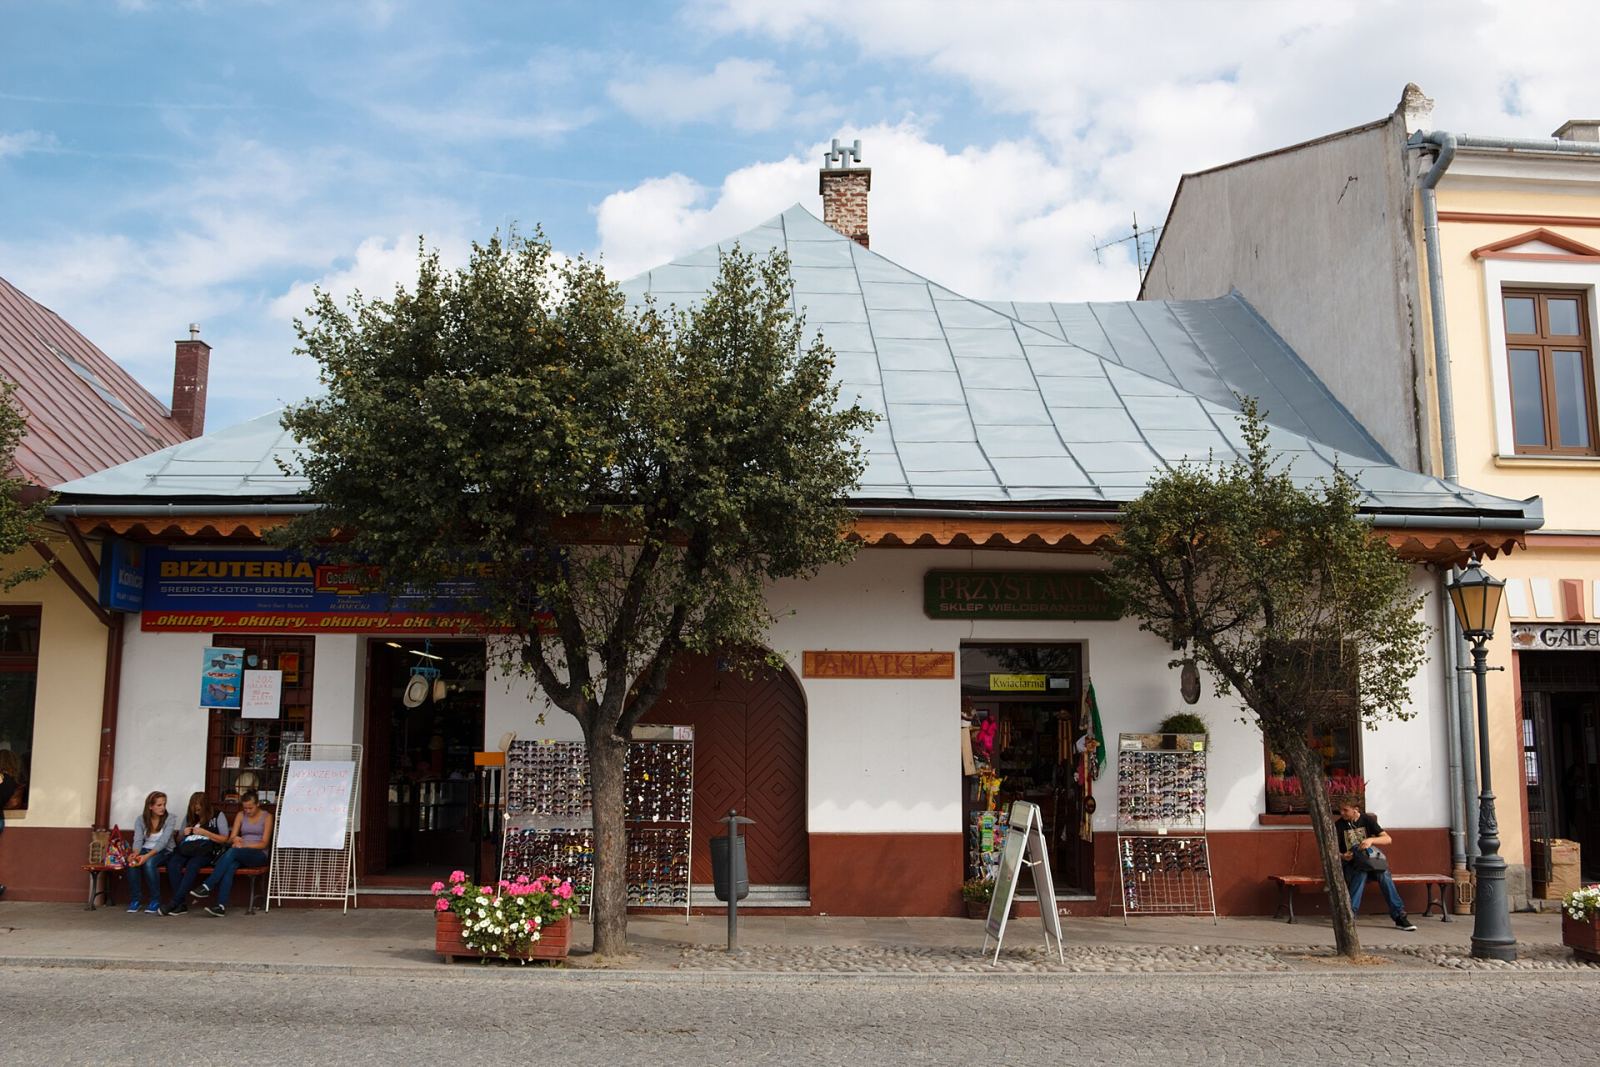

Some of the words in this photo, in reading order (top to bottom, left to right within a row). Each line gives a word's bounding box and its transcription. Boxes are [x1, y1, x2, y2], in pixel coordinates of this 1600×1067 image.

[160, 586, 206, 594] SREBRO
[211, 586, 249, 594] ZŁOTO
[254, 586, 314, 595] BURSZTYN
[939, 602, 984, 612] SKLEP
[993, 676, 1045, 689] Kwiaciarnia
